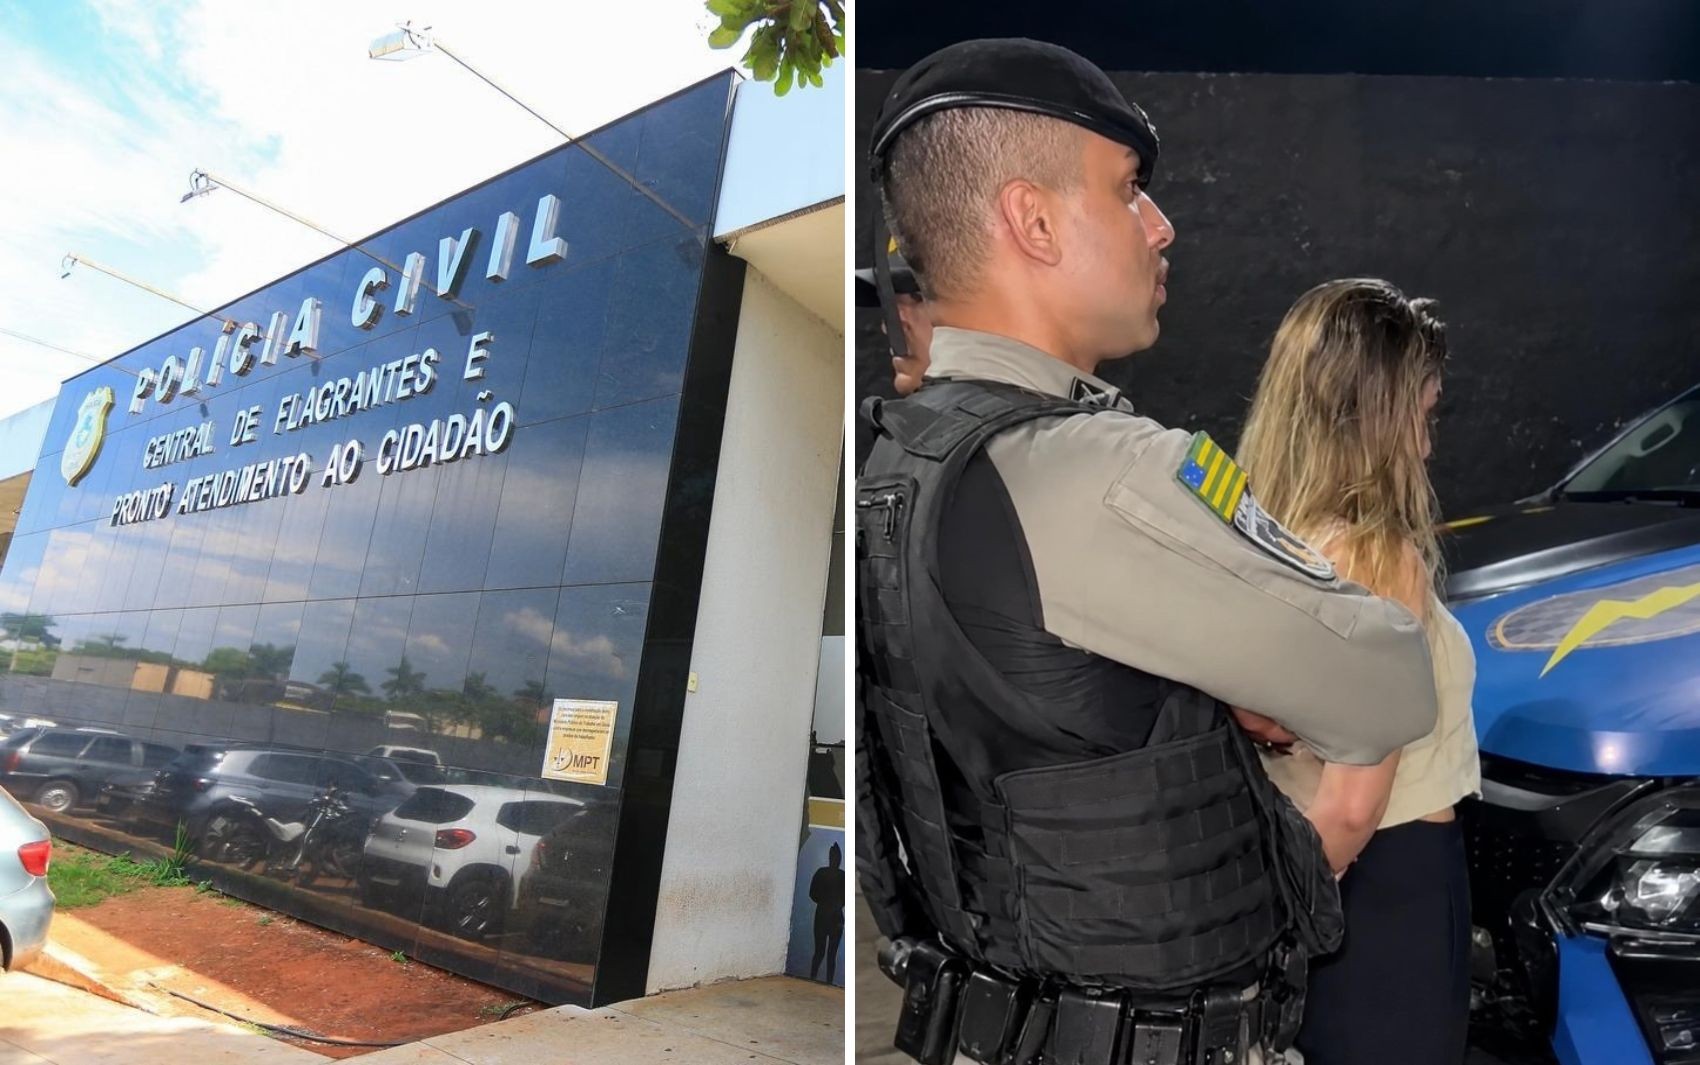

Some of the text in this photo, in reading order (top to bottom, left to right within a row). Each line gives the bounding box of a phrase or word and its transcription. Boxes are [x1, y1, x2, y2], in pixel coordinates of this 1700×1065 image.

[129, 194, 568, 414] POLÍCIA CIVIL
[110, 390, 515, 526] PRONTO ATENDIMENTO AO CIDADÃO
[143, 331, 494, 469] CENTRAL DE FLAGRANTES E
[573, 754, 600, 769] MPT
